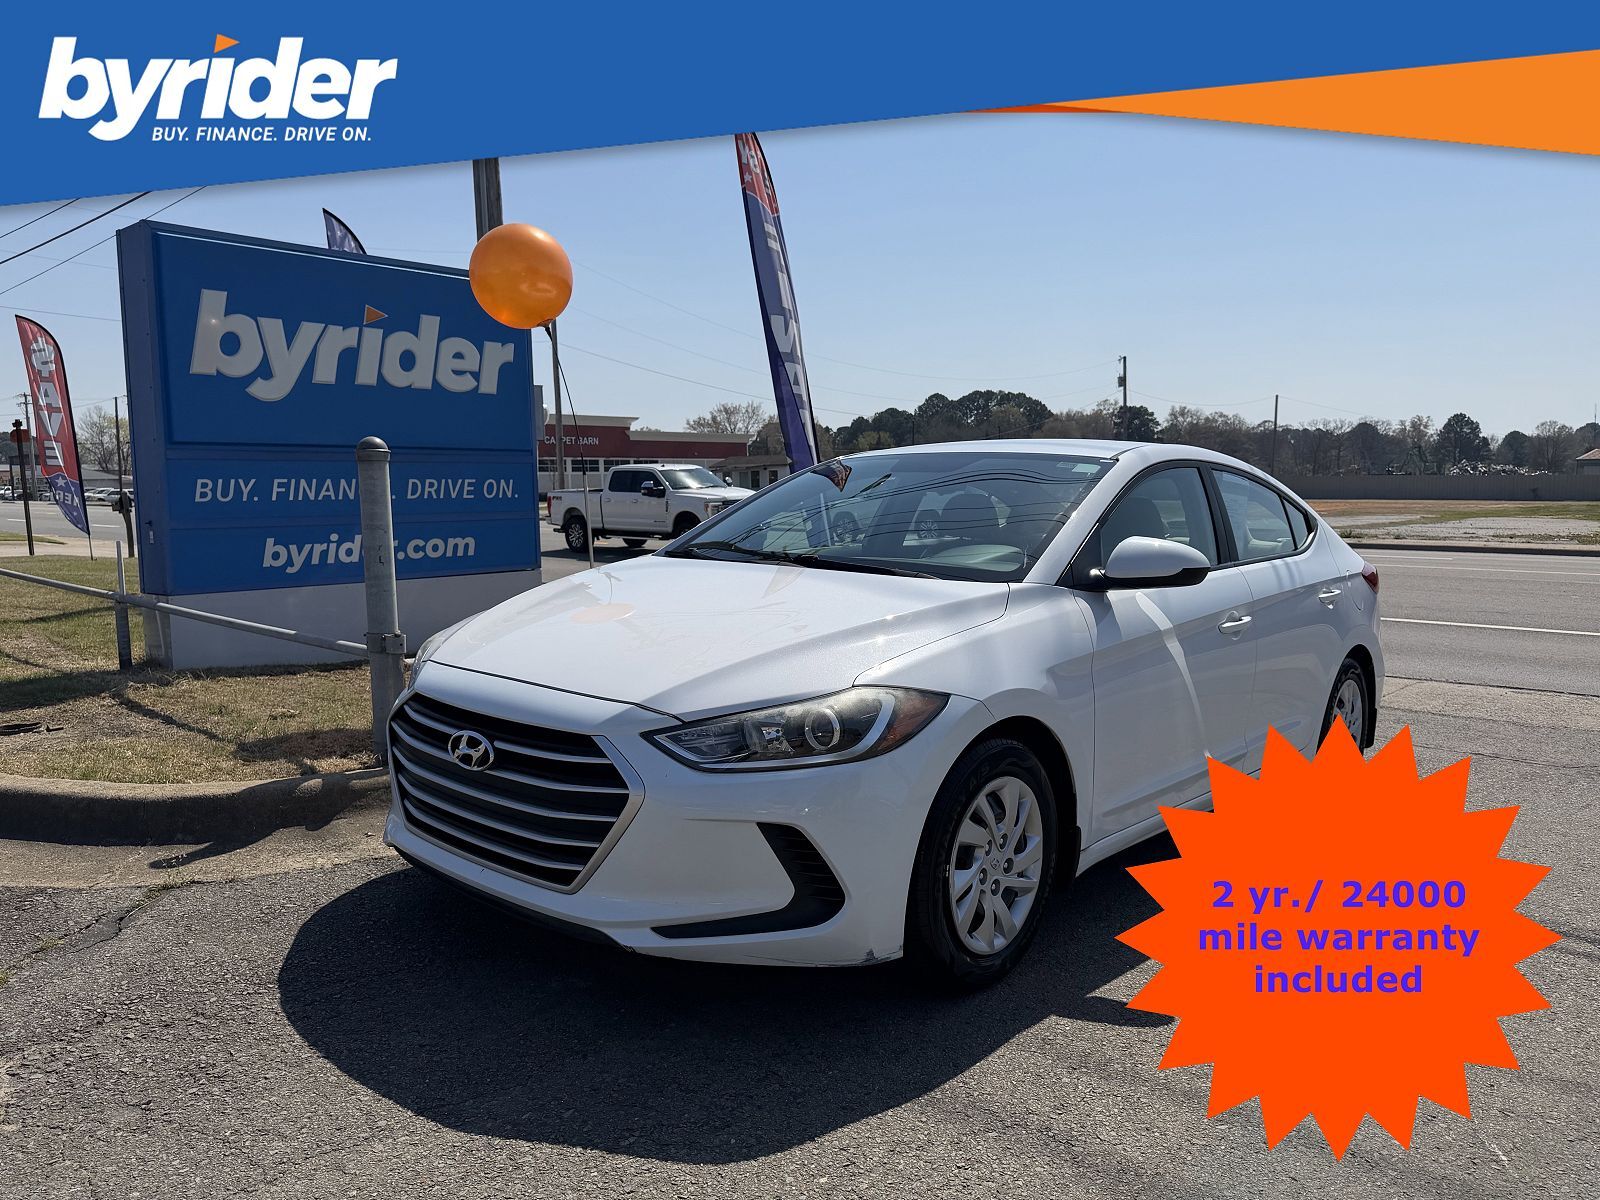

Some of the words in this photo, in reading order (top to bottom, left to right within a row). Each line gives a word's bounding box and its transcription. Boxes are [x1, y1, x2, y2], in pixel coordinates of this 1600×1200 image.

[189, 288, 515, 402] byrider
[544, 436, 576, 445] CAPET
[195, 479, 258, 502] BUY.
[271, 478, 396, 501] FINAN.
[407, 479, 476, 499] DRIVE
[484, 479, 518, 499] ON.
[262, 533, 475, 574] byrid.com
